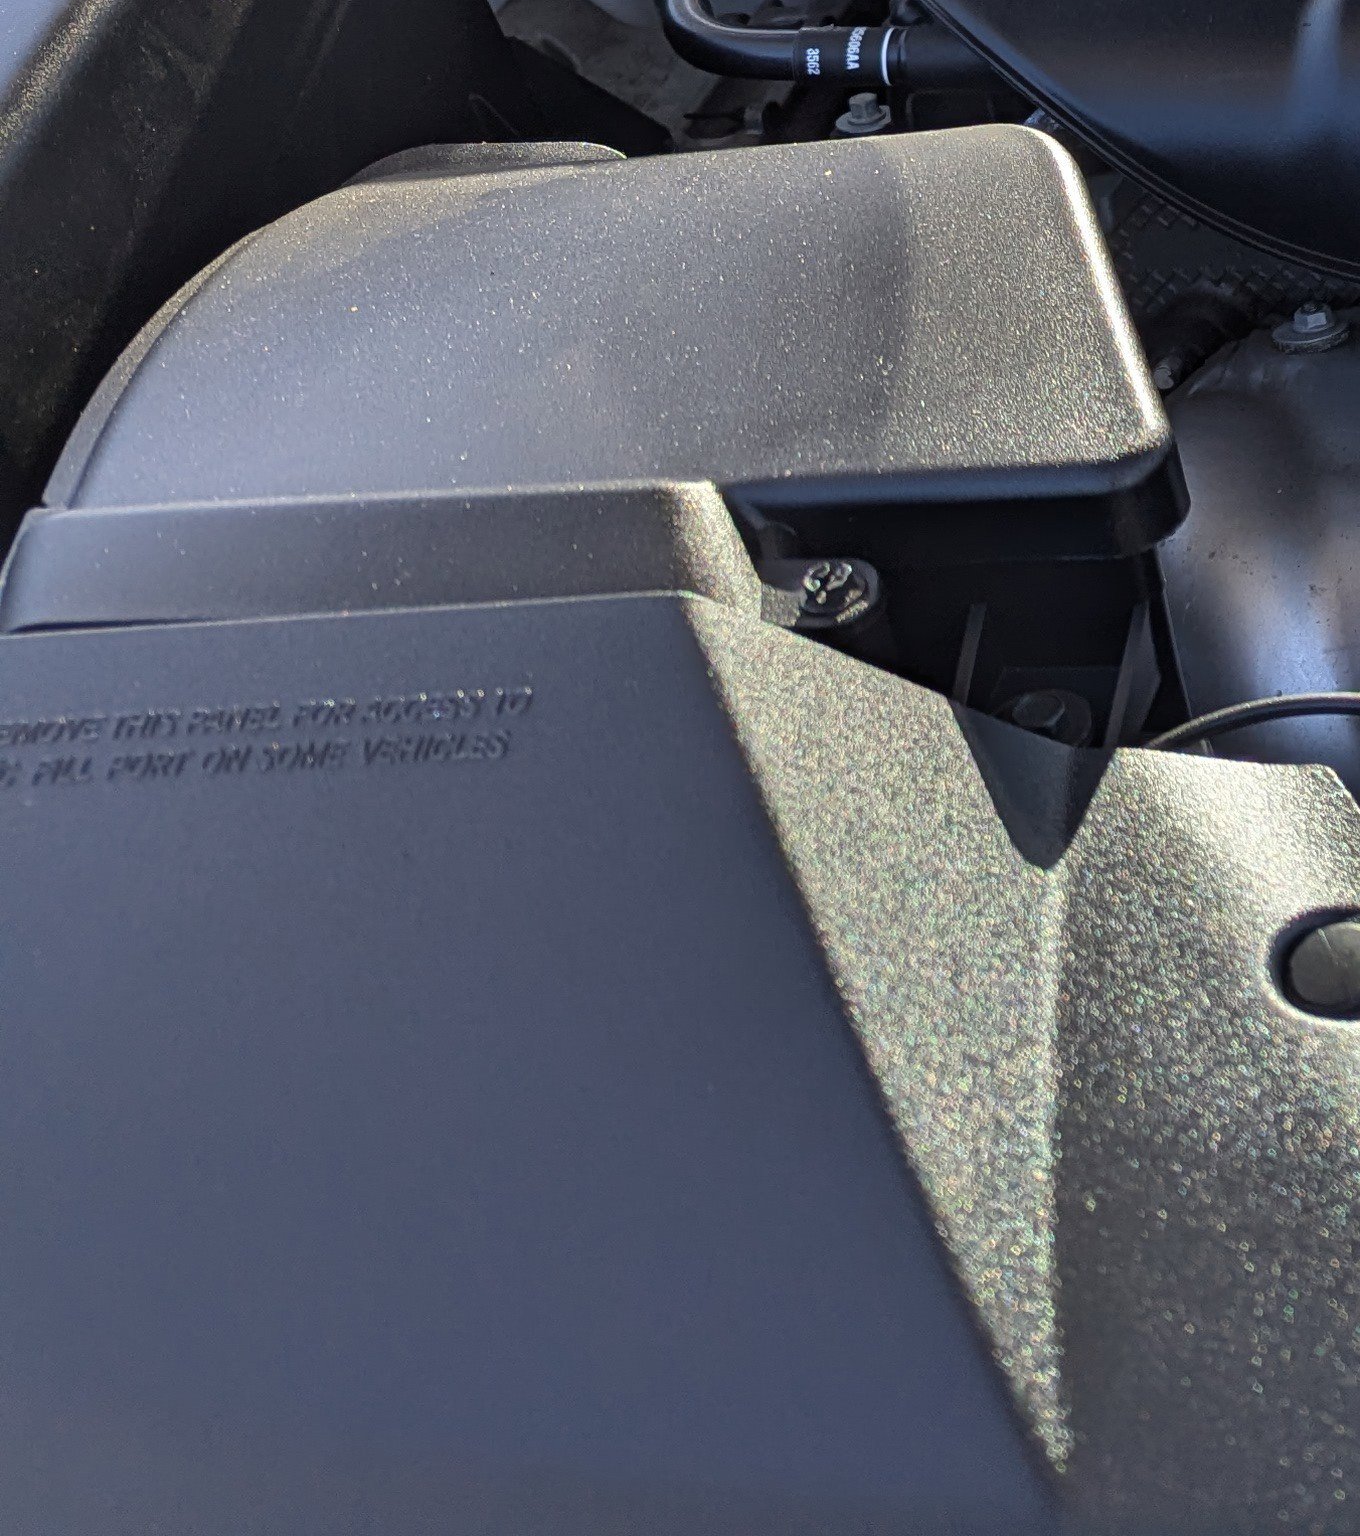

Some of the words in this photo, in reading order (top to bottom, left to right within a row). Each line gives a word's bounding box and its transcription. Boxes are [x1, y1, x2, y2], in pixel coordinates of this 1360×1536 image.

[805, 47, 821, 76] 3562
[0, 717, 106, 747] EMOVE
[112, 711, 178, 742] THIS
[187, 705, 281, 737] PANEL
[293, 701, 356, 729] FOR
[360, 694, 484, 725] ACCESS
[496, 689, 535, 716] TO
[105, 751, 195, 781] PORT
[202, 745, 252, 774] ON
[259, 741, 350, 772] SOME
[362, 731, 512, 765] VEHICLES
